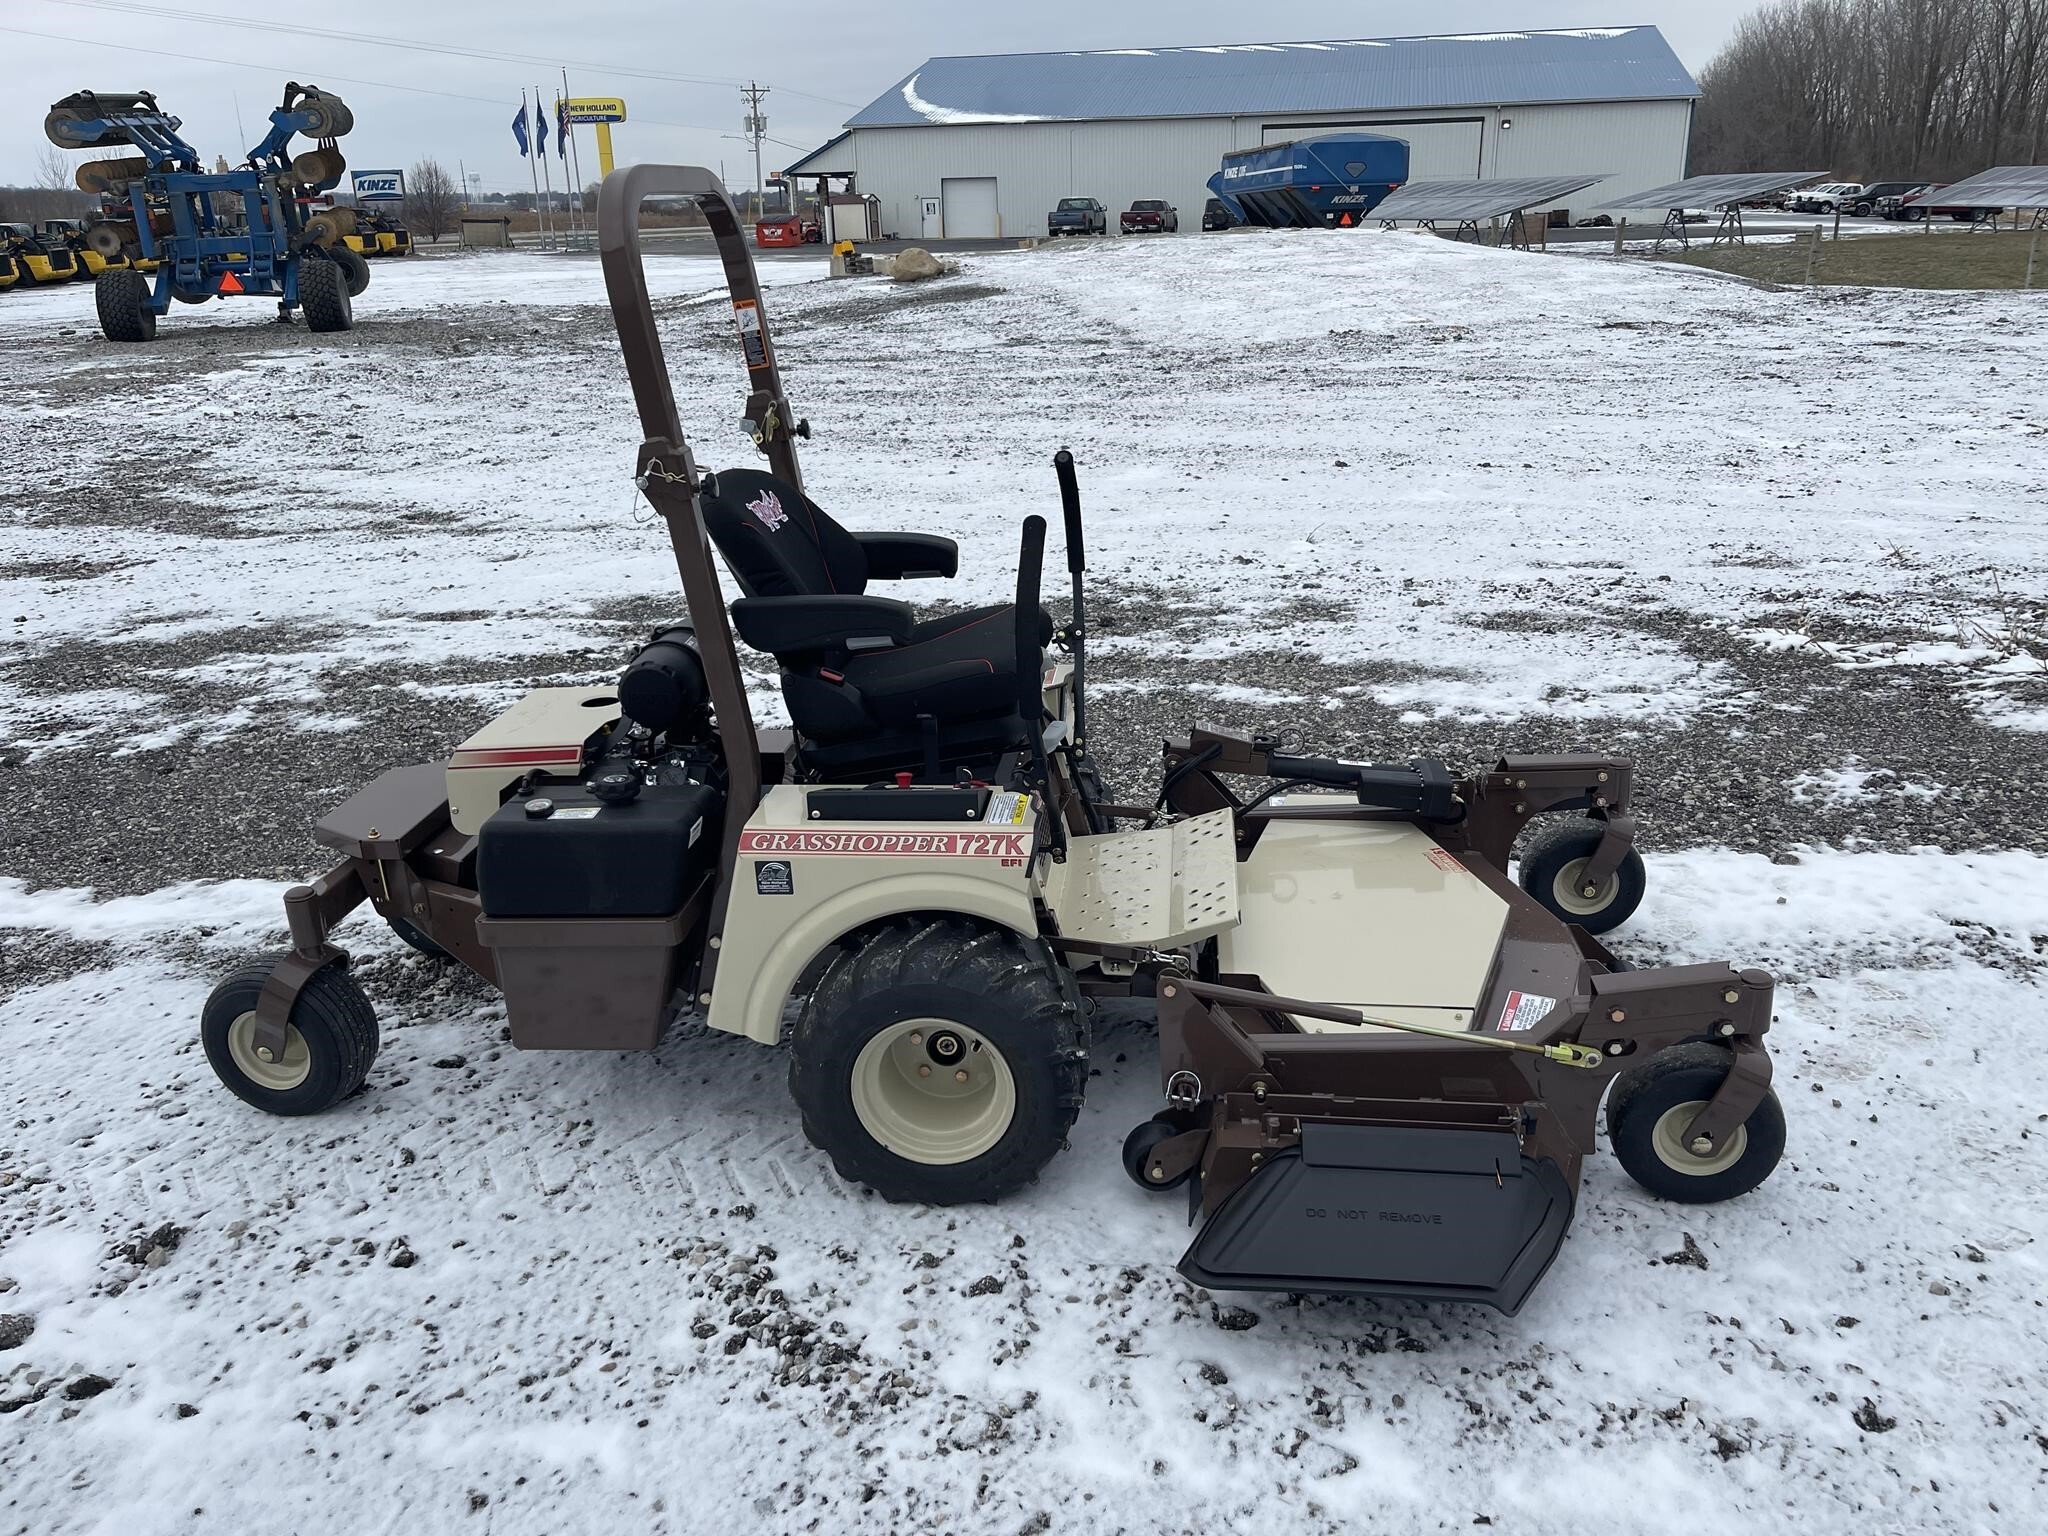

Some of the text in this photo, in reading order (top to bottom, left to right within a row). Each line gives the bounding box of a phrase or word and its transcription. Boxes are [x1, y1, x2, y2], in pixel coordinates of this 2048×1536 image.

[357, 179, 397, 191] KINZE
[1331, 195, 1368, 203] KINZE
[751, 834, 1024, 855] GRASSHOPPER 727K
[1306, 1208, 1442, 1224] DO NOT REMOVE
